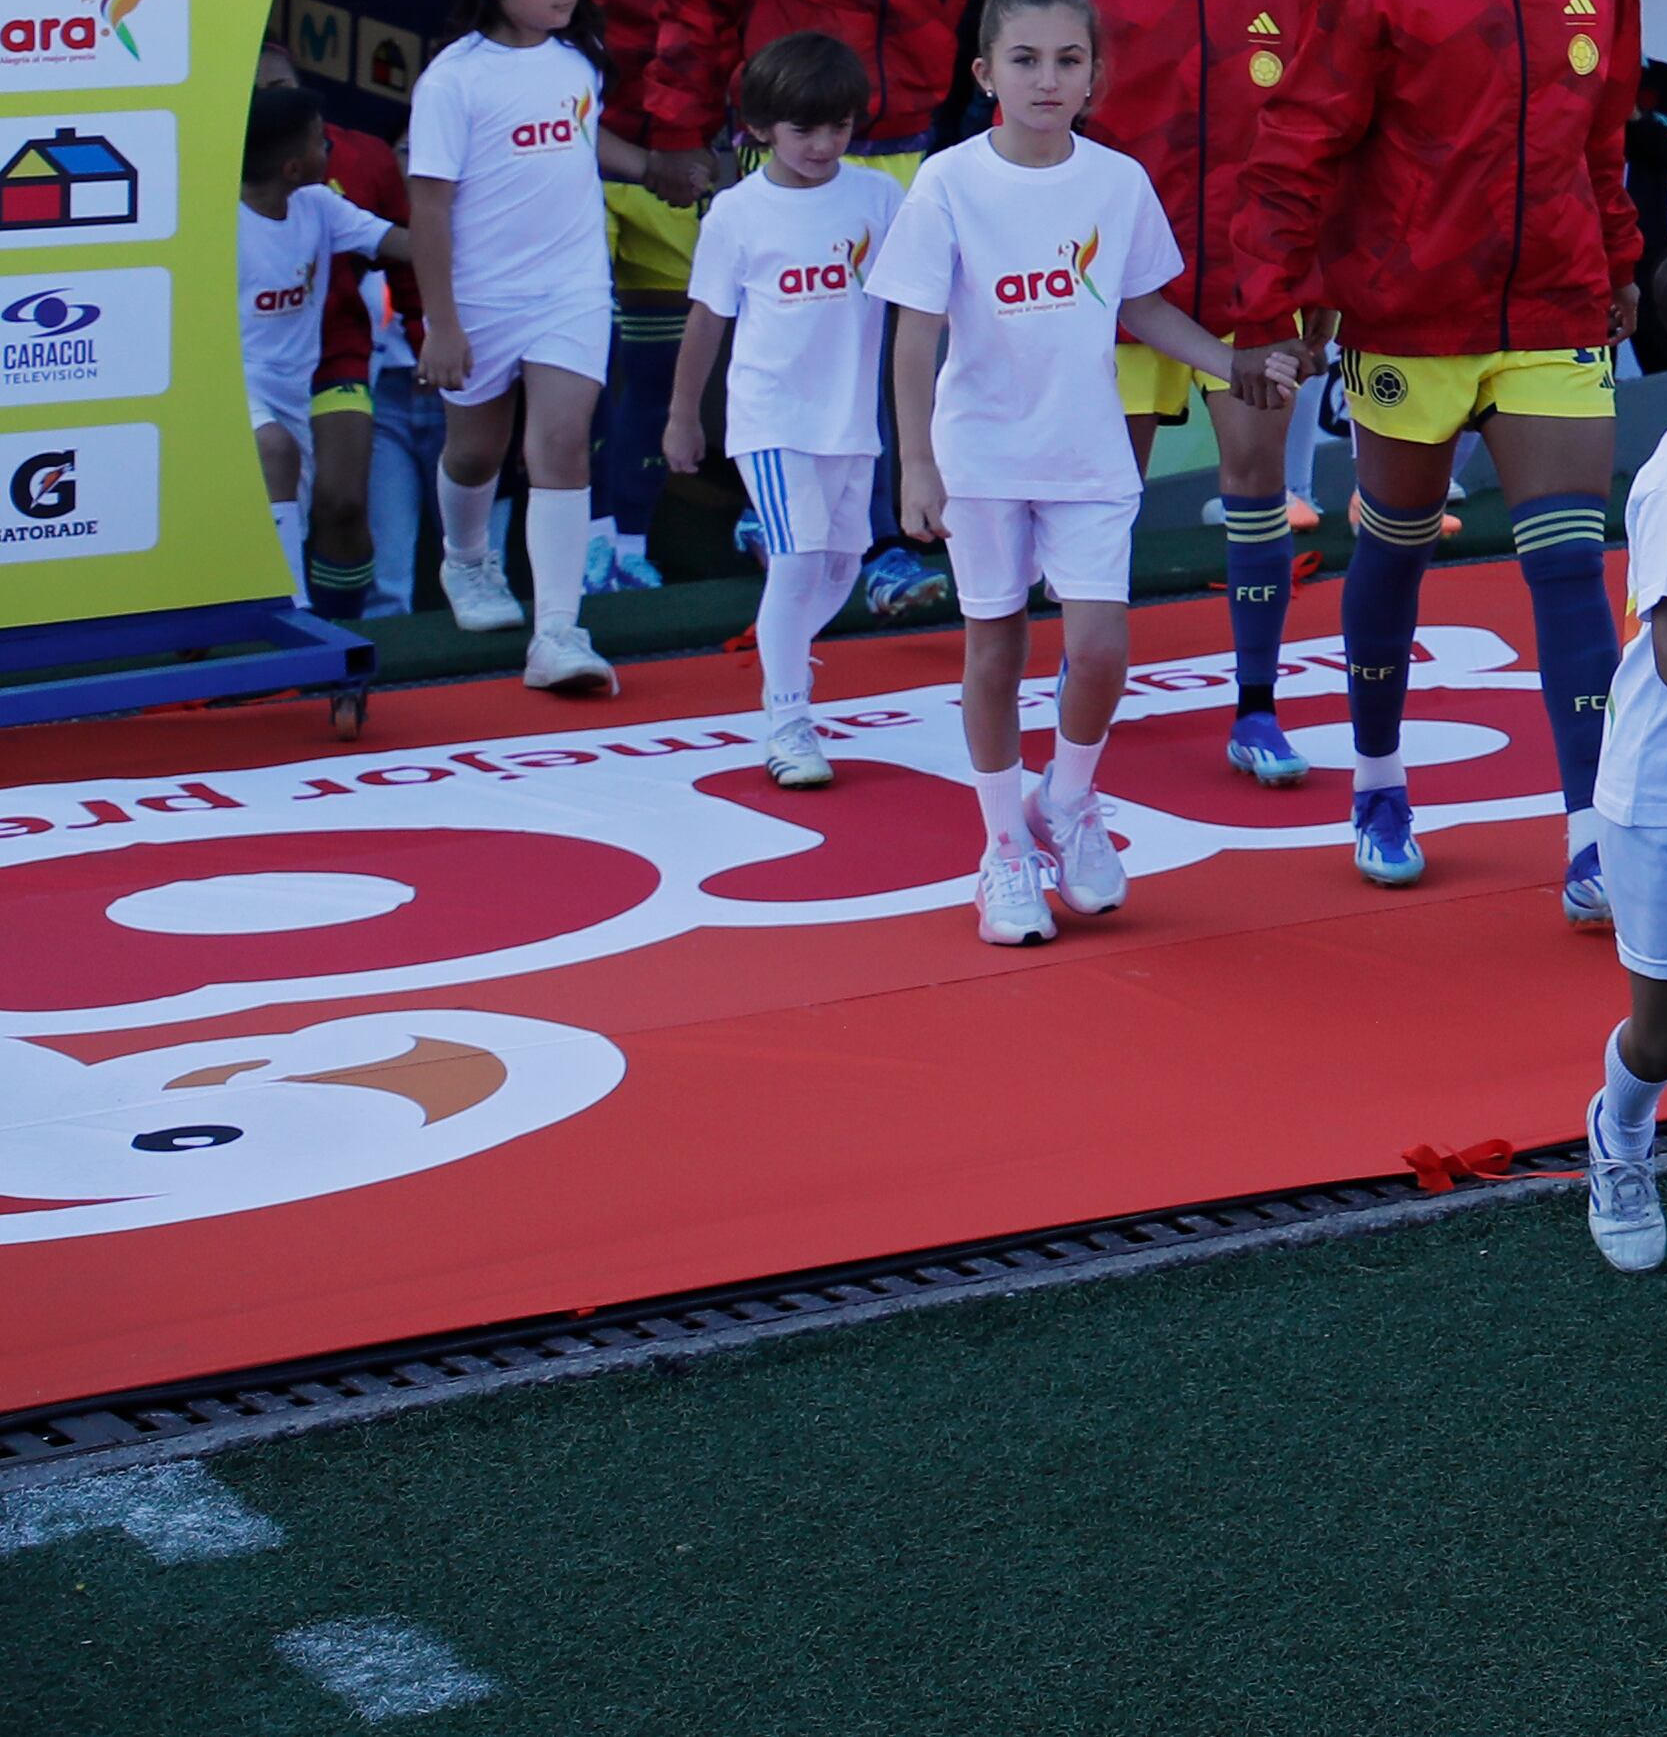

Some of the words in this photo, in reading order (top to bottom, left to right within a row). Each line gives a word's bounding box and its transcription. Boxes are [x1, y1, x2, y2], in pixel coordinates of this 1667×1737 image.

[0, 17, 97, 53] ara
[511, 119, 573, 148] ara
[779, 264, 848, 295] ara
[995, 269, 1074, 305] ara
[255, 286, 304, 312] ara
[3, 339, 98, 371] CARACOL
[0, 520, 98, 544] ATORADE
[1235, 584, 1277, 604] FCF
[1349, 662, 1396, 682] FCF
[1573, 695, 1607, 713] FC
